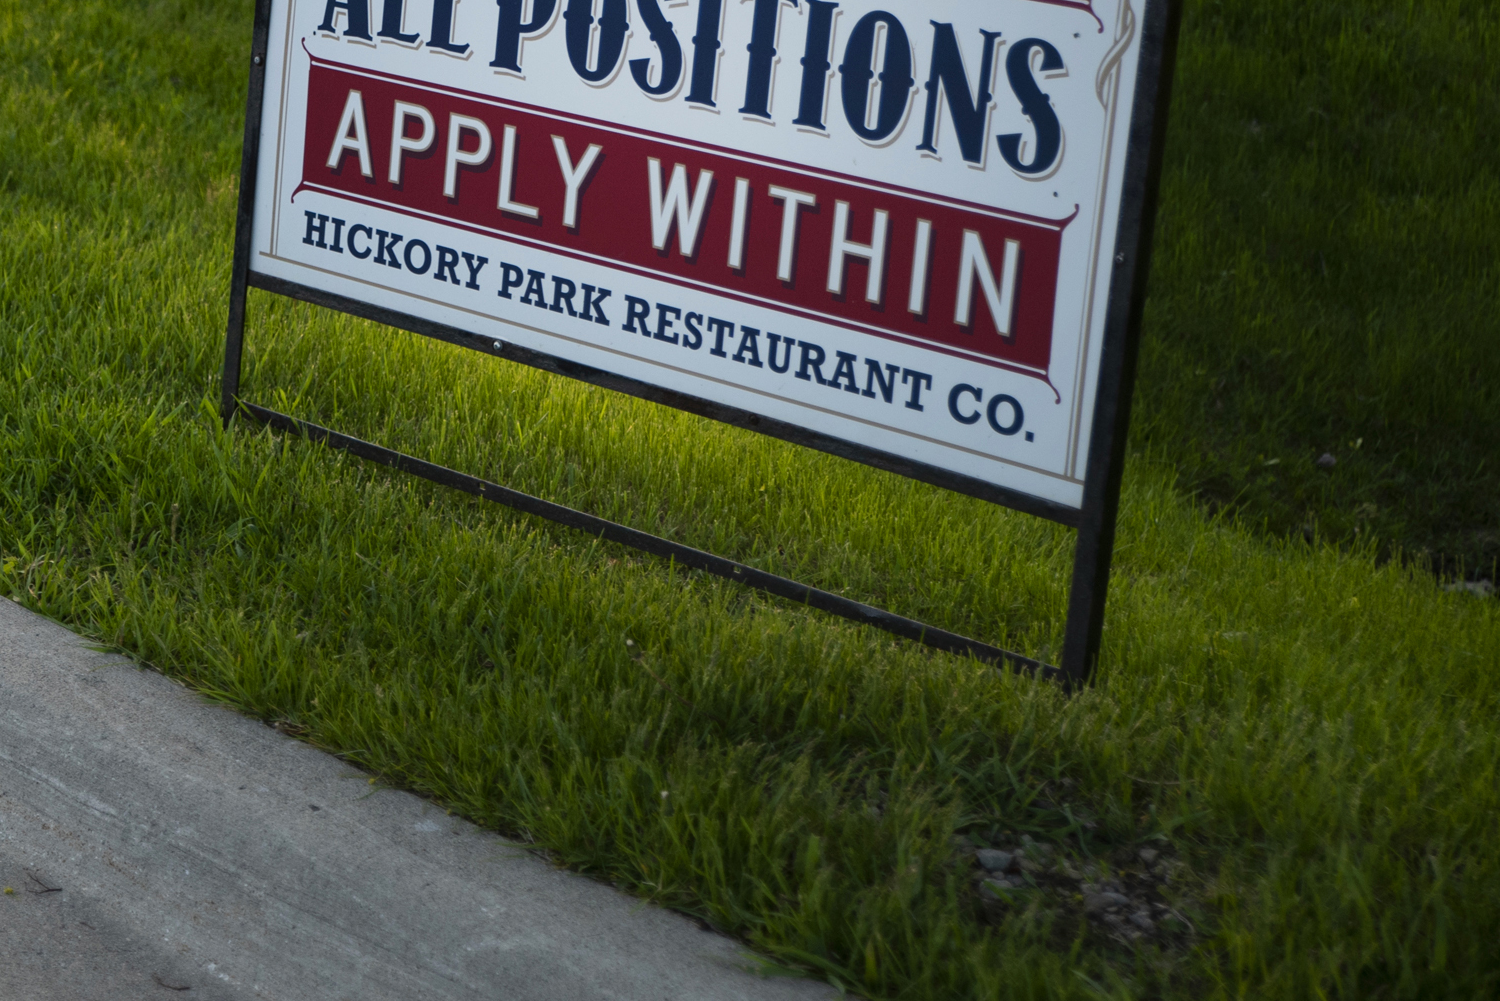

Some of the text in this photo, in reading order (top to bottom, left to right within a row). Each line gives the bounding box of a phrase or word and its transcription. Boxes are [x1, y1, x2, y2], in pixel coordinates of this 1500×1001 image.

[302, 209, 1036, 444] HICKORY PARK RESTAURANT CO.
[324, 87, 1021, 337] APPLY WITHIN
